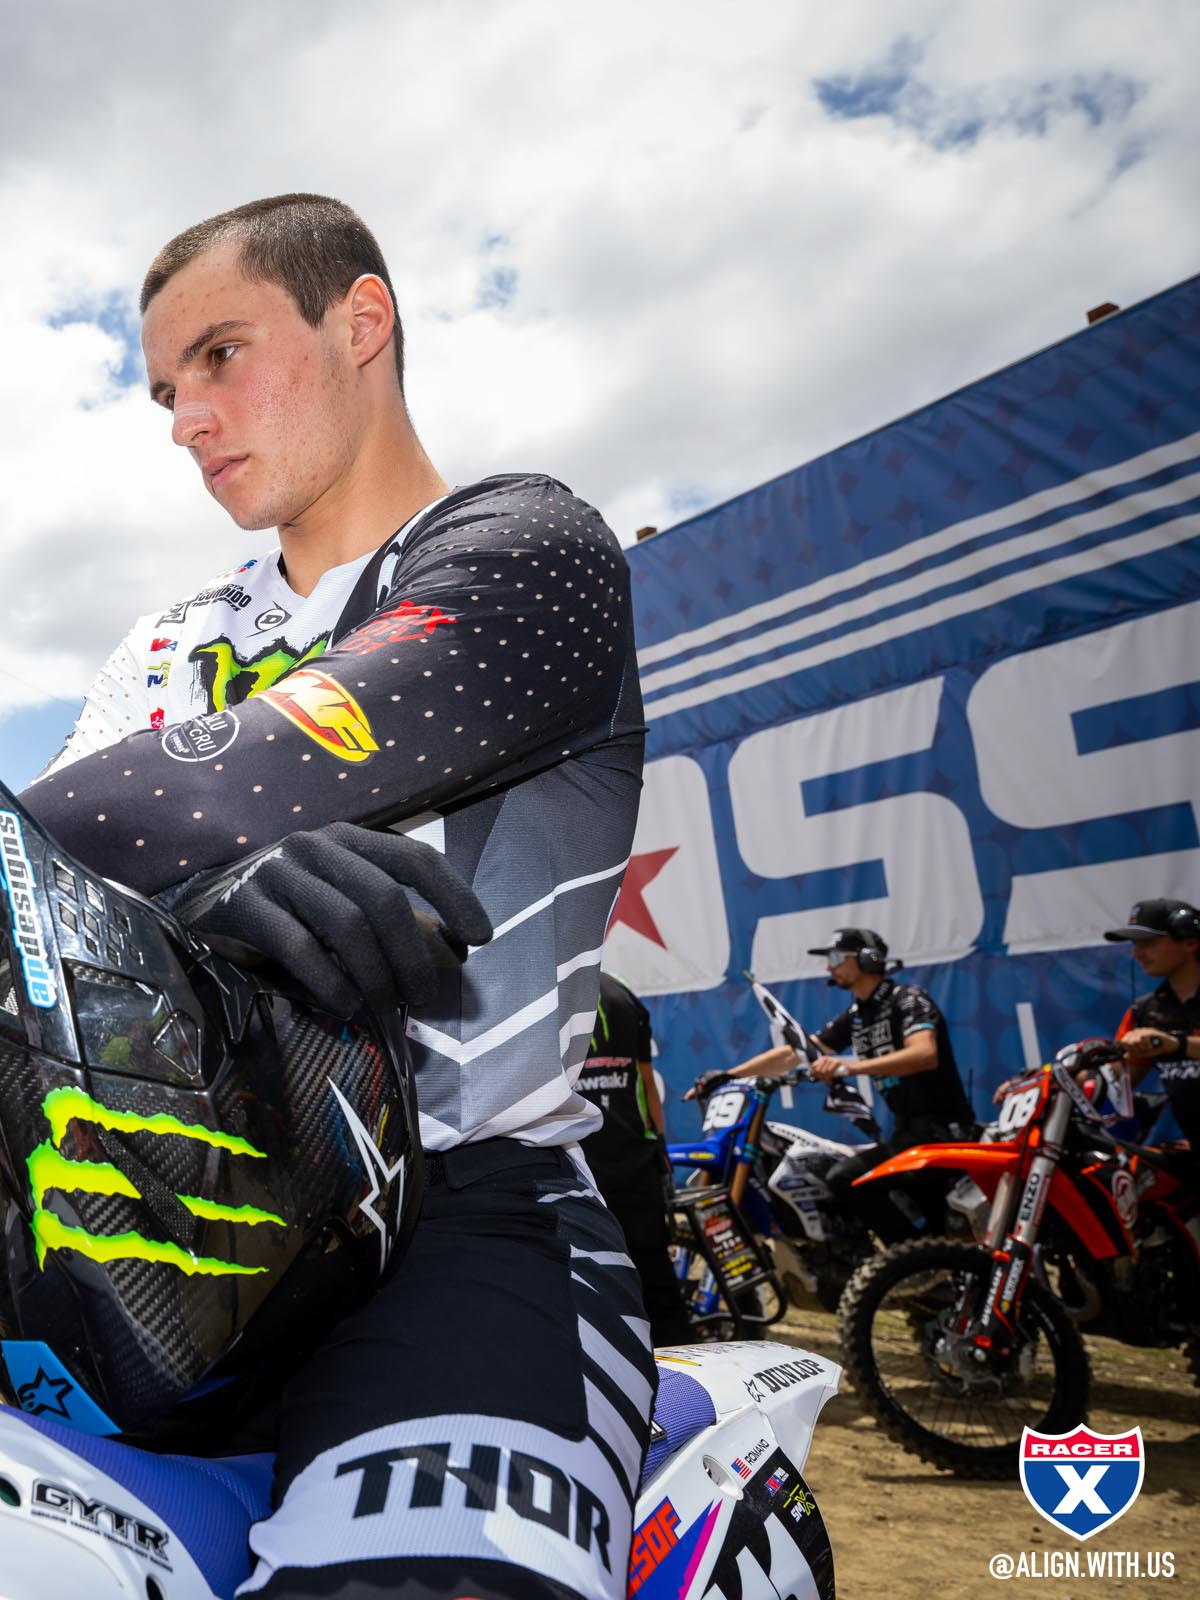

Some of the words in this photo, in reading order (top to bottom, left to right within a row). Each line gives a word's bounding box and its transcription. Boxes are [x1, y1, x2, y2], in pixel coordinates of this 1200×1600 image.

[1021, 1172, 1041, 1223] ENZO
[753, 1358, 825, 1394] DUNLOP
[744, 1438, 770, 1466] ROMANO
[31, 1479, 170, 1563] GYTR
[334, 1442, 613, 1576] THOR
